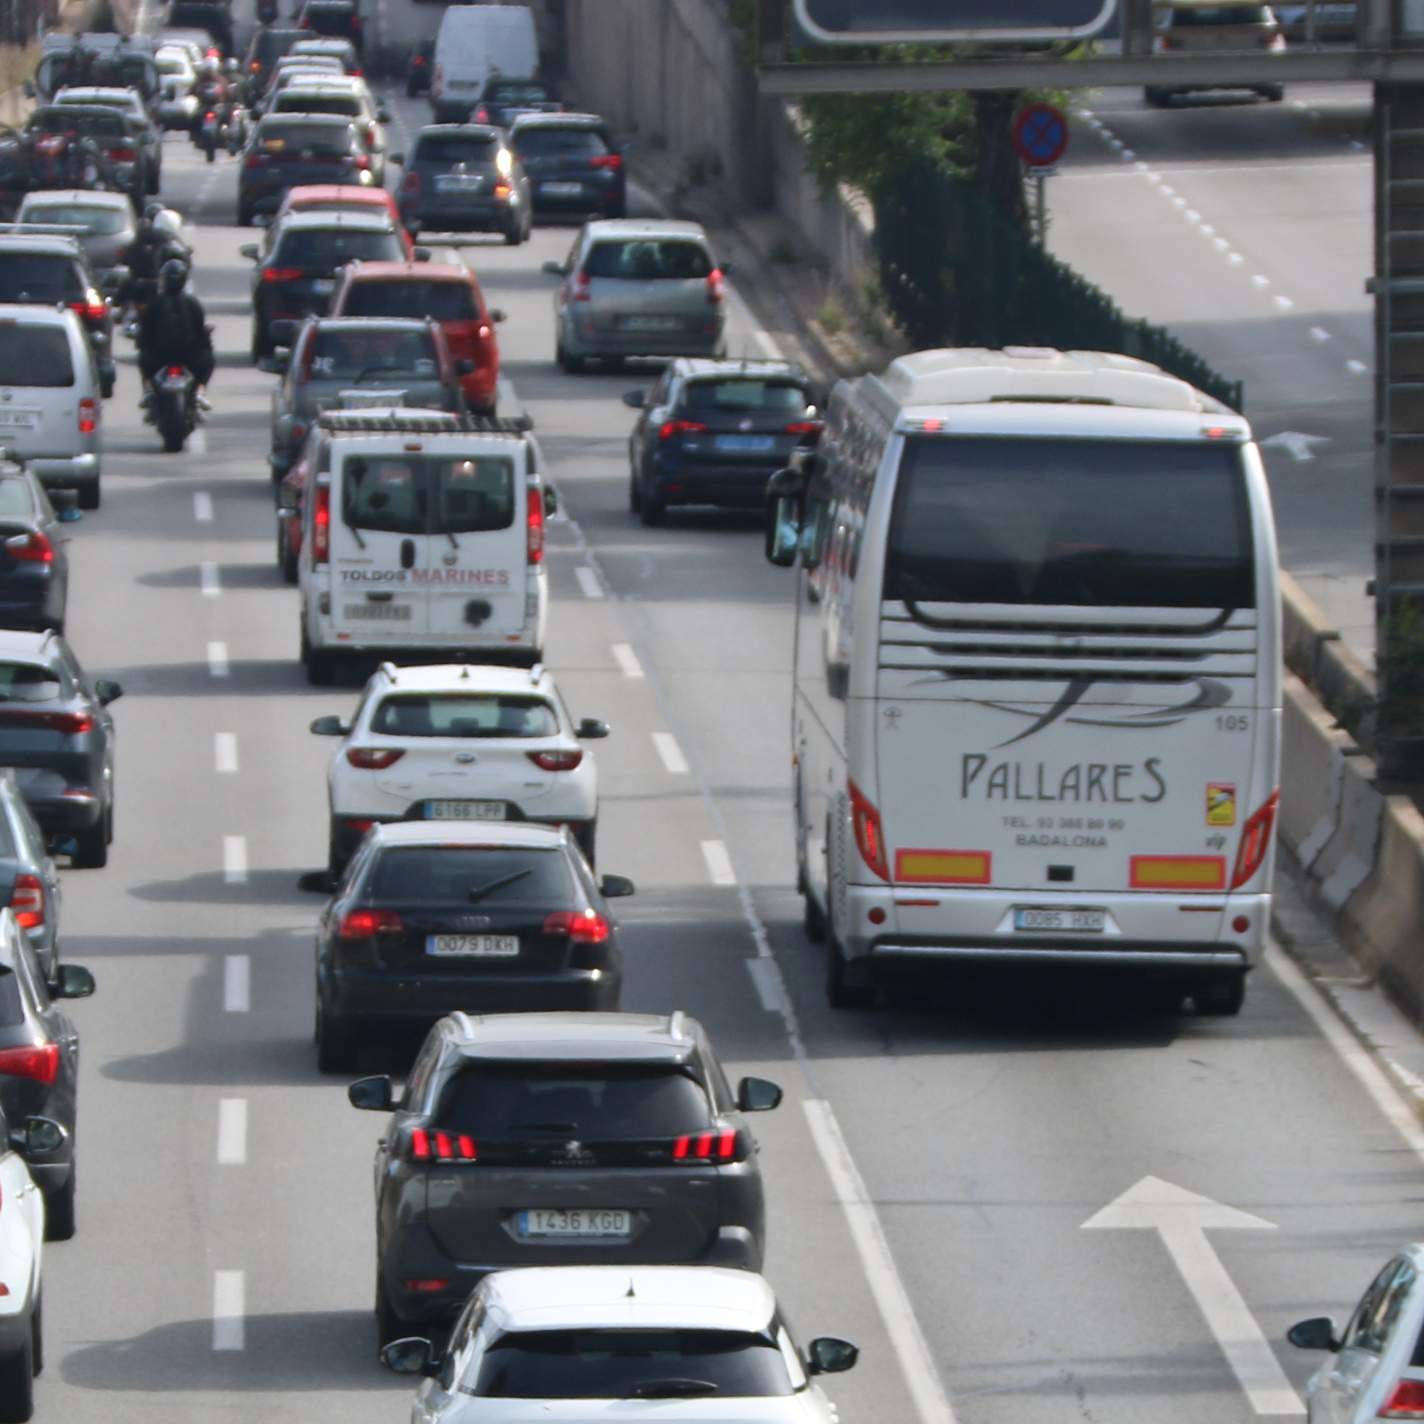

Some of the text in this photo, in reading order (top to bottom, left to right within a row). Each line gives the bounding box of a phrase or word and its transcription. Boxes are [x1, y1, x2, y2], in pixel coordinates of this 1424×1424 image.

[340, 568, 510, 585] TOLDOS MARINES
[1213, 714, 1249, 731] 105
[959, 753, 1167, 803] PALLARES
[1014, 834, 1109, 848] BADALONA
[535, 1211, 625, 1231] 1436 KGD
